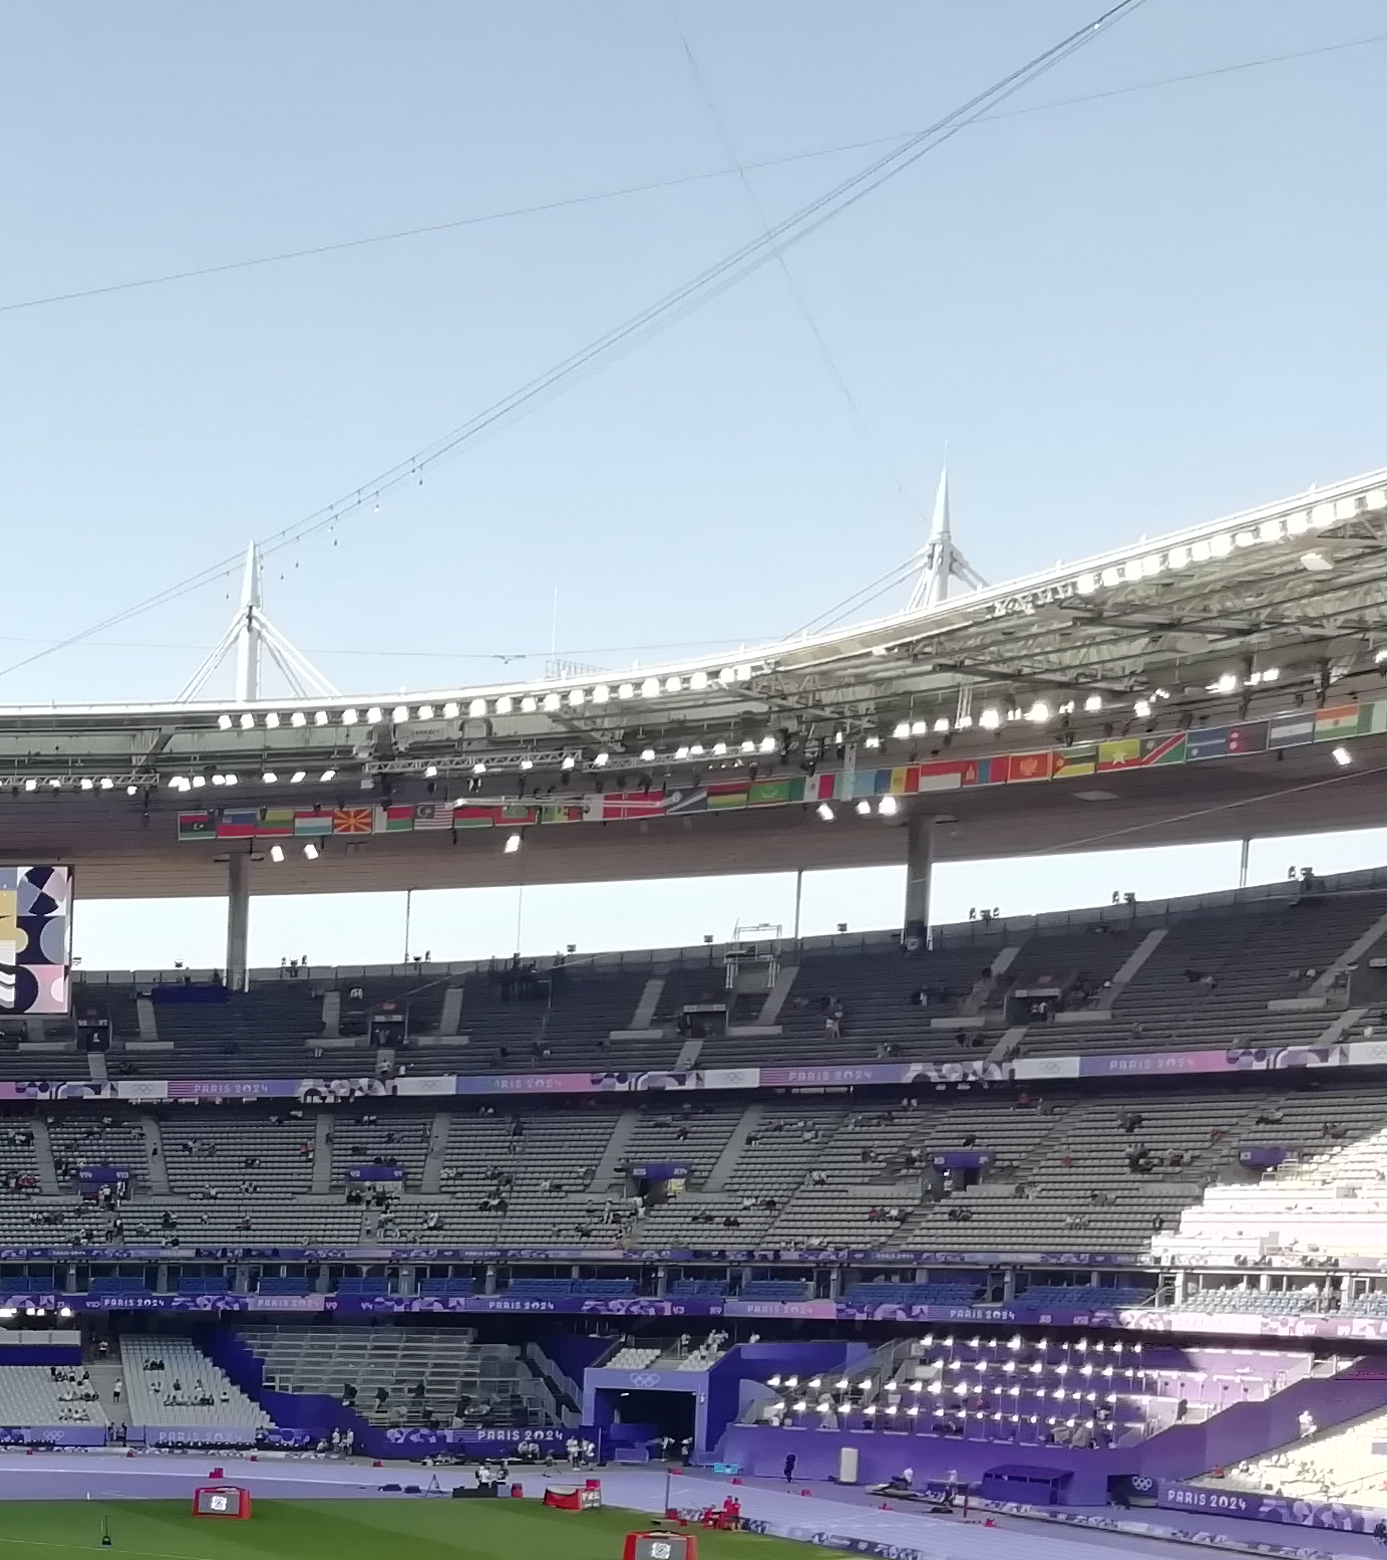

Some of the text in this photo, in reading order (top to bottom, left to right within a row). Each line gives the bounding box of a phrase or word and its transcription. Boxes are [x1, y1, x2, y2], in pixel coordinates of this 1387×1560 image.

[1110, 1058, 1194, 1070] PARIS 2024
[788, 1070, 873, 1081] PARIS 2024
[530, 1079, 562, 1088] 2024
[194, 1084, 268, 1094] PARIS 2024
[257, 1299, 320, 1307] PARIS 2024
[489, 1301, 554, 1310] PARIS 2024
[747, 1305, 814, 1315] PARIS 2024
[950, 1309, 1016, 1320] PARIS 2024
[477, 1430, 563, 1440] PARIS 2024
[1168, 1489, 1247, 1511] PARIS 2024
